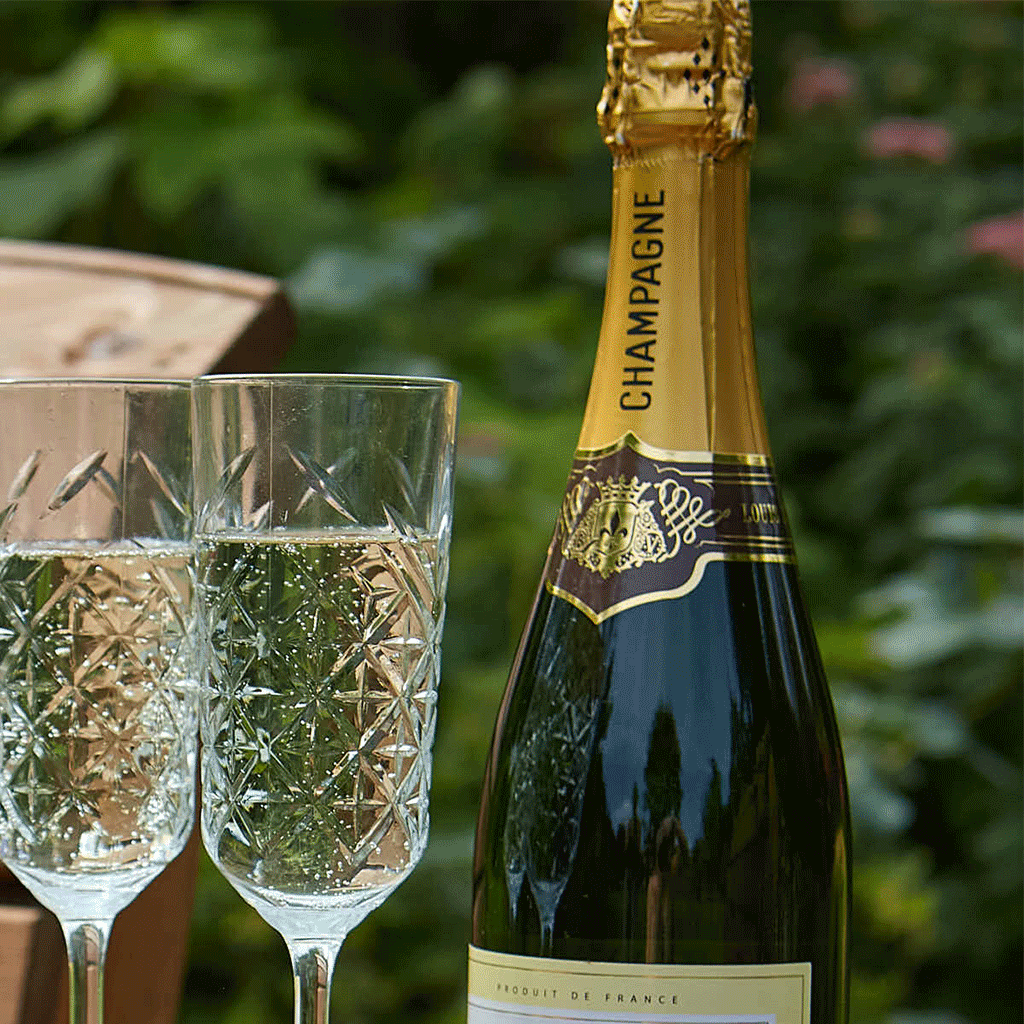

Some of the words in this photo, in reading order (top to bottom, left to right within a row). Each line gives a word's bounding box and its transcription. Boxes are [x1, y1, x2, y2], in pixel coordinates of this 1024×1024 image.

[619, 189, 665, 411] CHAMPAGNE
[497, 983, 558, 999] PRODUIT
[571, 991, 590, 1002] DE
[605, 993, 678, 1006] FRANCE
